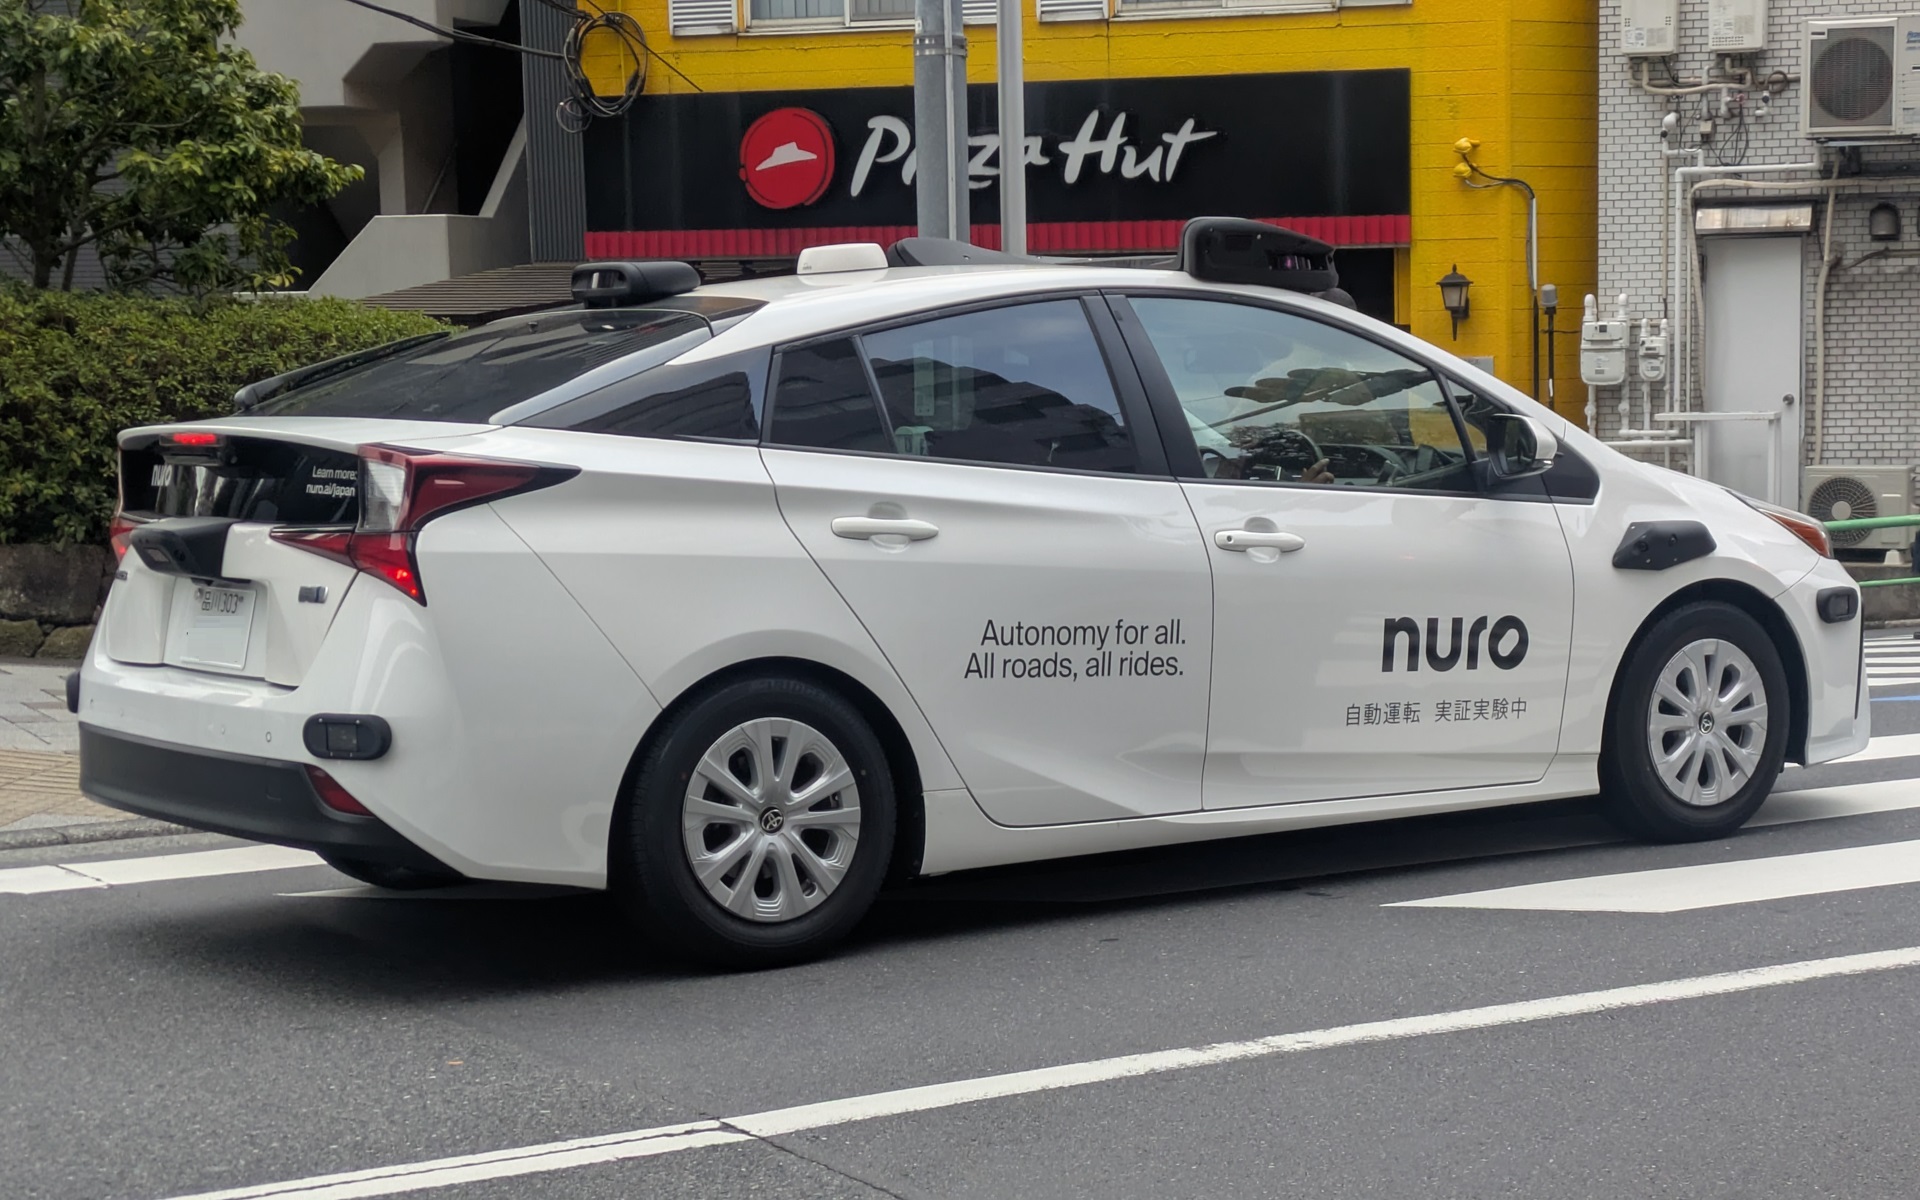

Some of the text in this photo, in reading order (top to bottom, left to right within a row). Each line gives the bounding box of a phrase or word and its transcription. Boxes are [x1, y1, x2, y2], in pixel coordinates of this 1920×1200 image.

[1058, 109, 1217, 184] Hut
[151, 464, 172, 486] nuro
[312, 465, 334, 478] Learn
[306, 483, 356, 498] nuro.ai/japan
[980, 618, 1187, 652] Autonomy for all.
[1381, 614, 1530, 673] nuro
[963, 650, 1185, 683] All roads, all rides.
[1345, 696, 1528, 727] 自動運転 実証実験中
